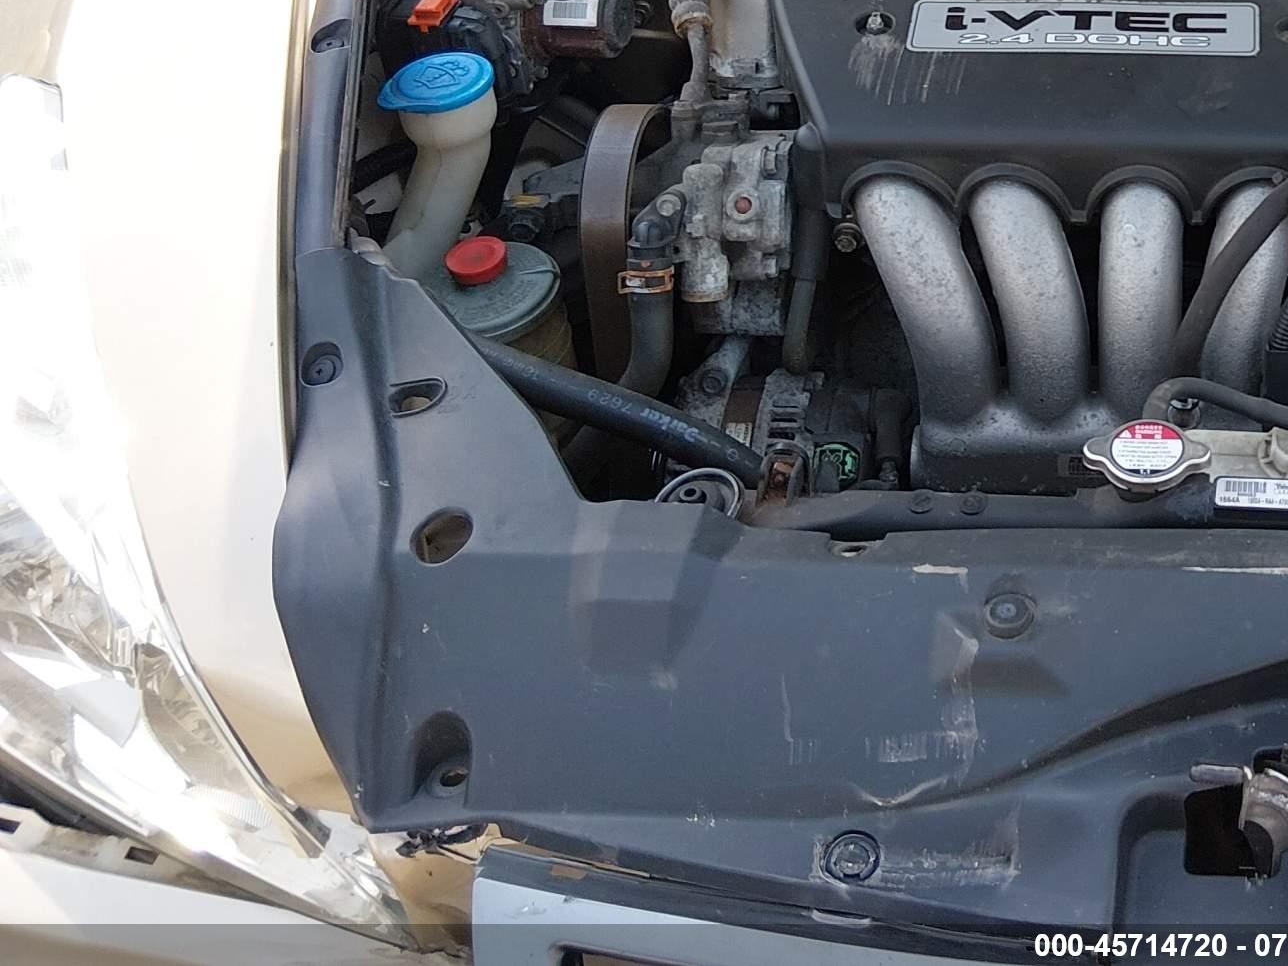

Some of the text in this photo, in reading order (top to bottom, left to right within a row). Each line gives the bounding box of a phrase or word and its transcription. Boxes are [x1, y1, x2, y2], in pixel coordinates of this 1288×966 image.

[944, 6, 1228, 34] i-VTEC
[958, 33, 1212, 48] 2.4 DOHC
